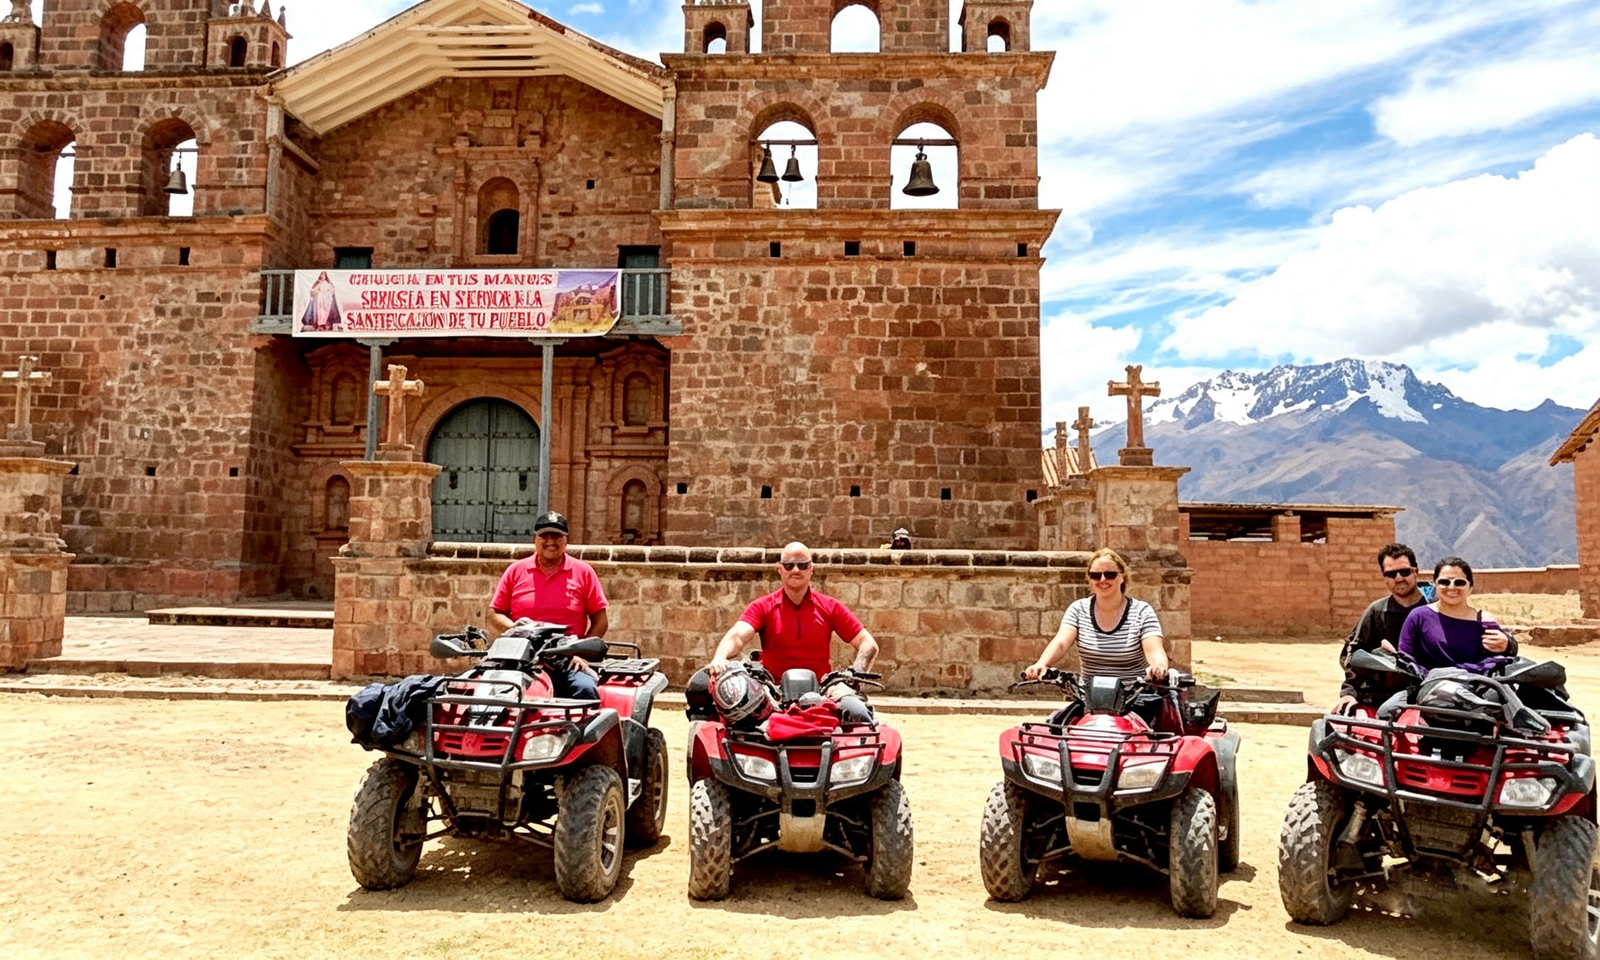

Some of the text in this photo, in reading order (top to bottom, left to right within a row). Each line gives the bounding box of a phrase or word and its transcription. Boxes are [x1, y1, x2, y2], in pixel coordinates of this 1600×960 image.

[430, 290, 450, 308] EN
[468, 312, 485, 329] TU
[490, 312, 546, 329] PUEBLO
